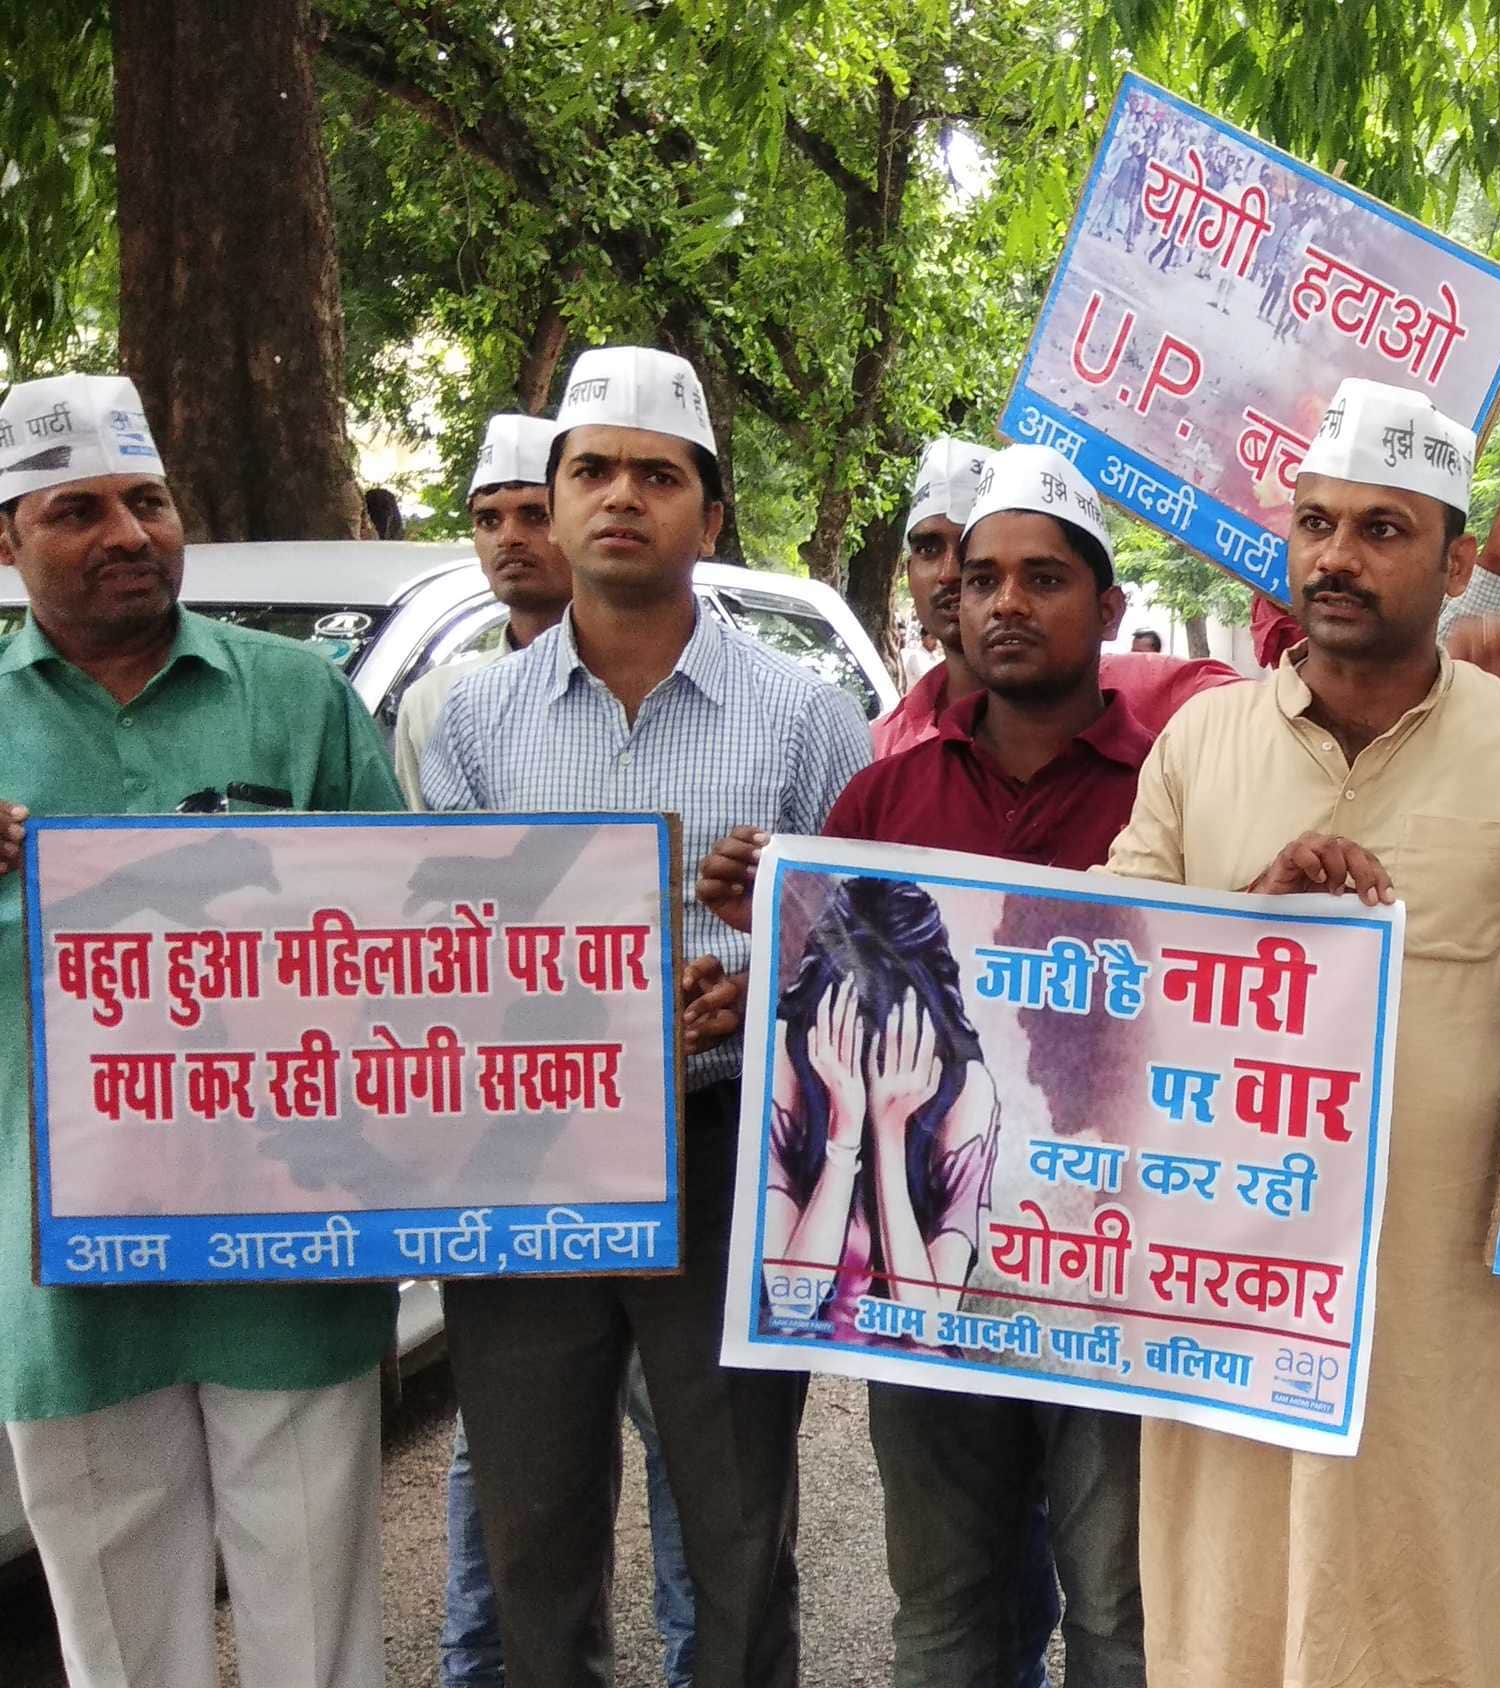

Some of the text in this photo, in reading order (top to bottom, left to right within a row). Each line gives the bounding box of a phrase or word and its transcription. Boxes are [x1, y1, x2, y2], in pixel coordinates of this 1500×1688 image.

[1145, 152, 1464, 382] योगी हटाओ
[1074, 297, 1200, 436] U.P.
[26, 401, 72, 438] पार्टी
[1383, 420, 1414, 467] मुझे
[1424, 433, 1461, 475] चाहि
[1018, 406, 1284, 591] आम आदमी पार्टी,
[1041, 471, 1067, 503] मुझे
[56, 904, 650, 1027] बहुत हुआ महिलाओं पर वार
[976, 937, 1317, 1034] जारी है नारी
[91, 1027, 622, 1120] क्या कर रही योगी सरकार
[1151, 1059, 1360, 1142] पर वार
[1030, 1141, 1317, 1216] क्या कर रही
[67, 1234, 169, 1272] आम
[208, 1216, 359, 1268] आदमी
[990, 1201, 1343, 1323] योगी सरकार
[771, 1276, 837, 1320] aap
[859, 1301, 1252, 1386] आम आदमी पार्टी, बलिया
[1275, 1348, 1338, 1400] aap
